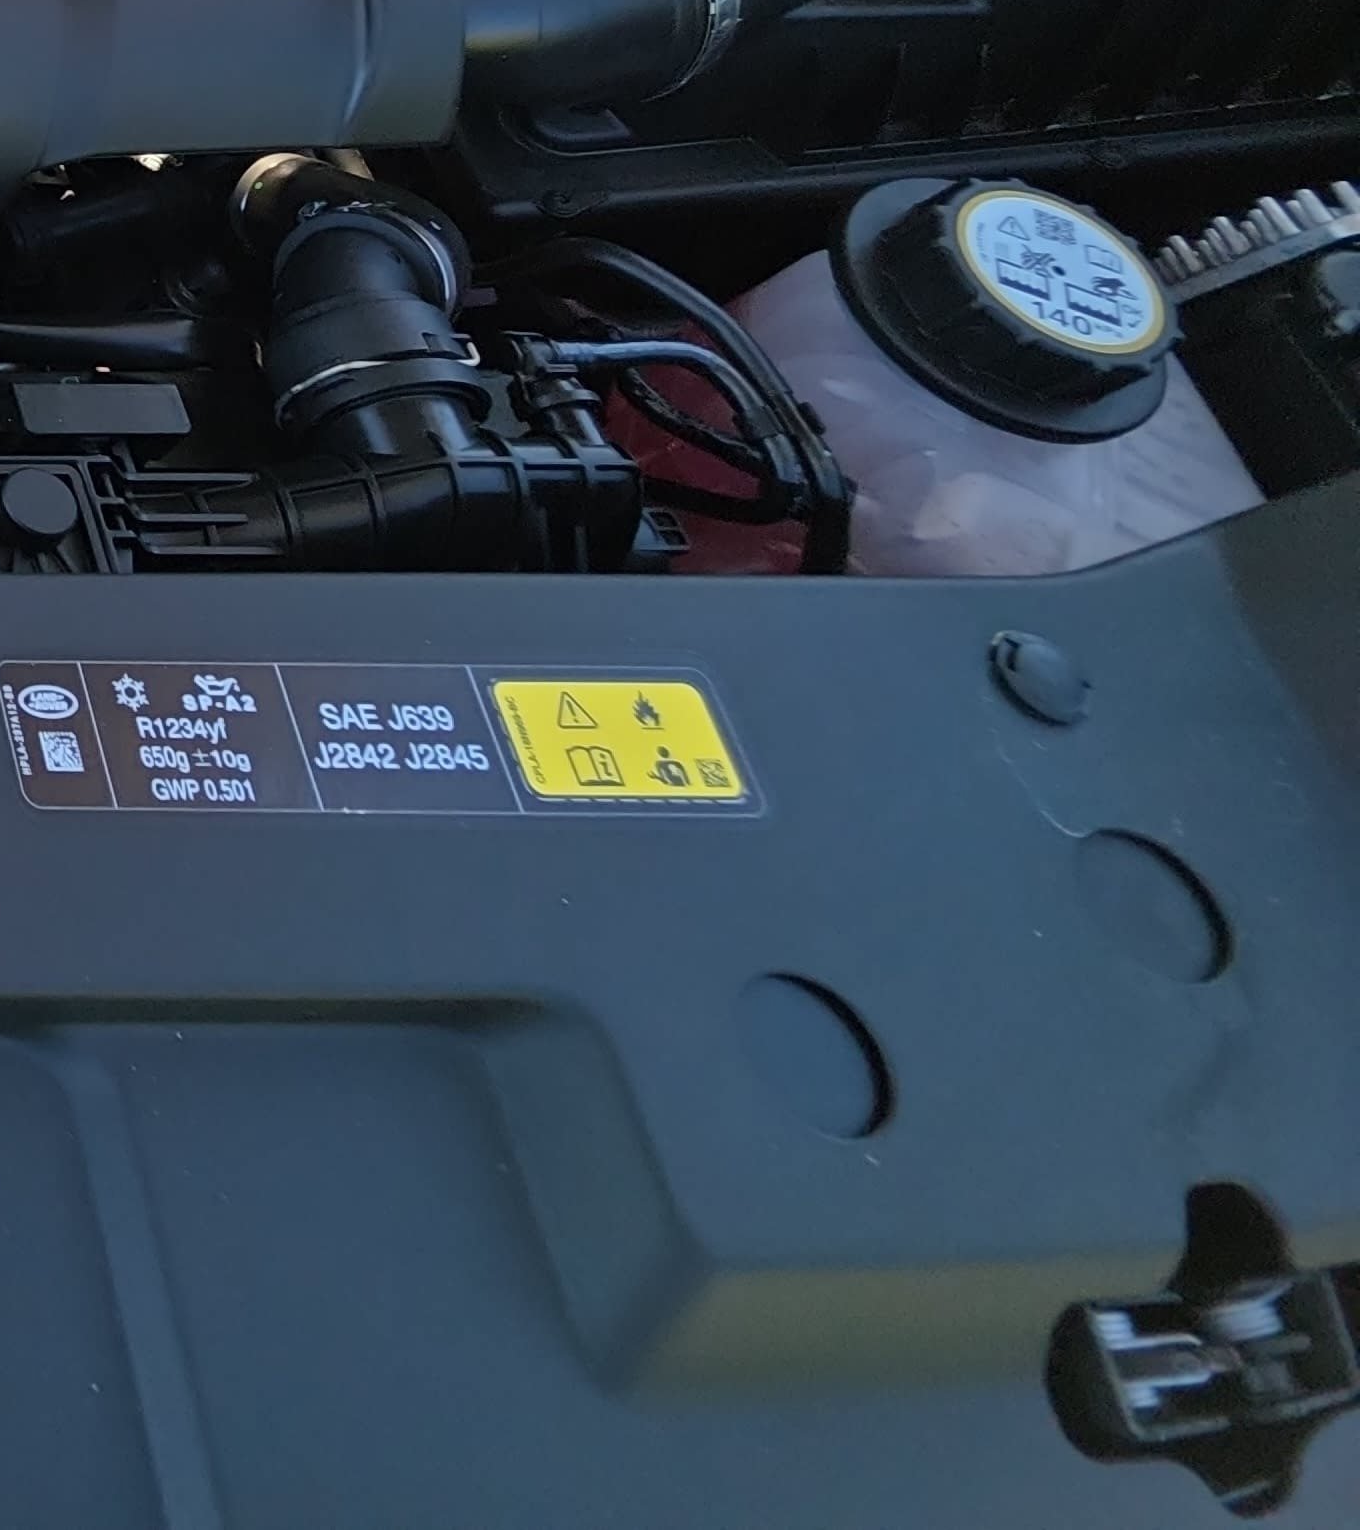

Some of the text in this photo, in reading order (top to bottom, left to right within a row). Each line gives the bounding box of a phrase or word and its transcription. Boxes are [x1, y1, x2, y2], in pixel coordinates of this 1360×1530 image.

[1031, 301, 1092, 336] 140
[182, 693, 257, 713] SP-A2
[319, 702, 455, 731] SAE J639
[136, 716, 228, 745] R1234yf
[139, 746, 191, 774] 650g
[314, 741, 489, 770] J2842 J2845
[151, 778, 256, 802] GWP 0.501
